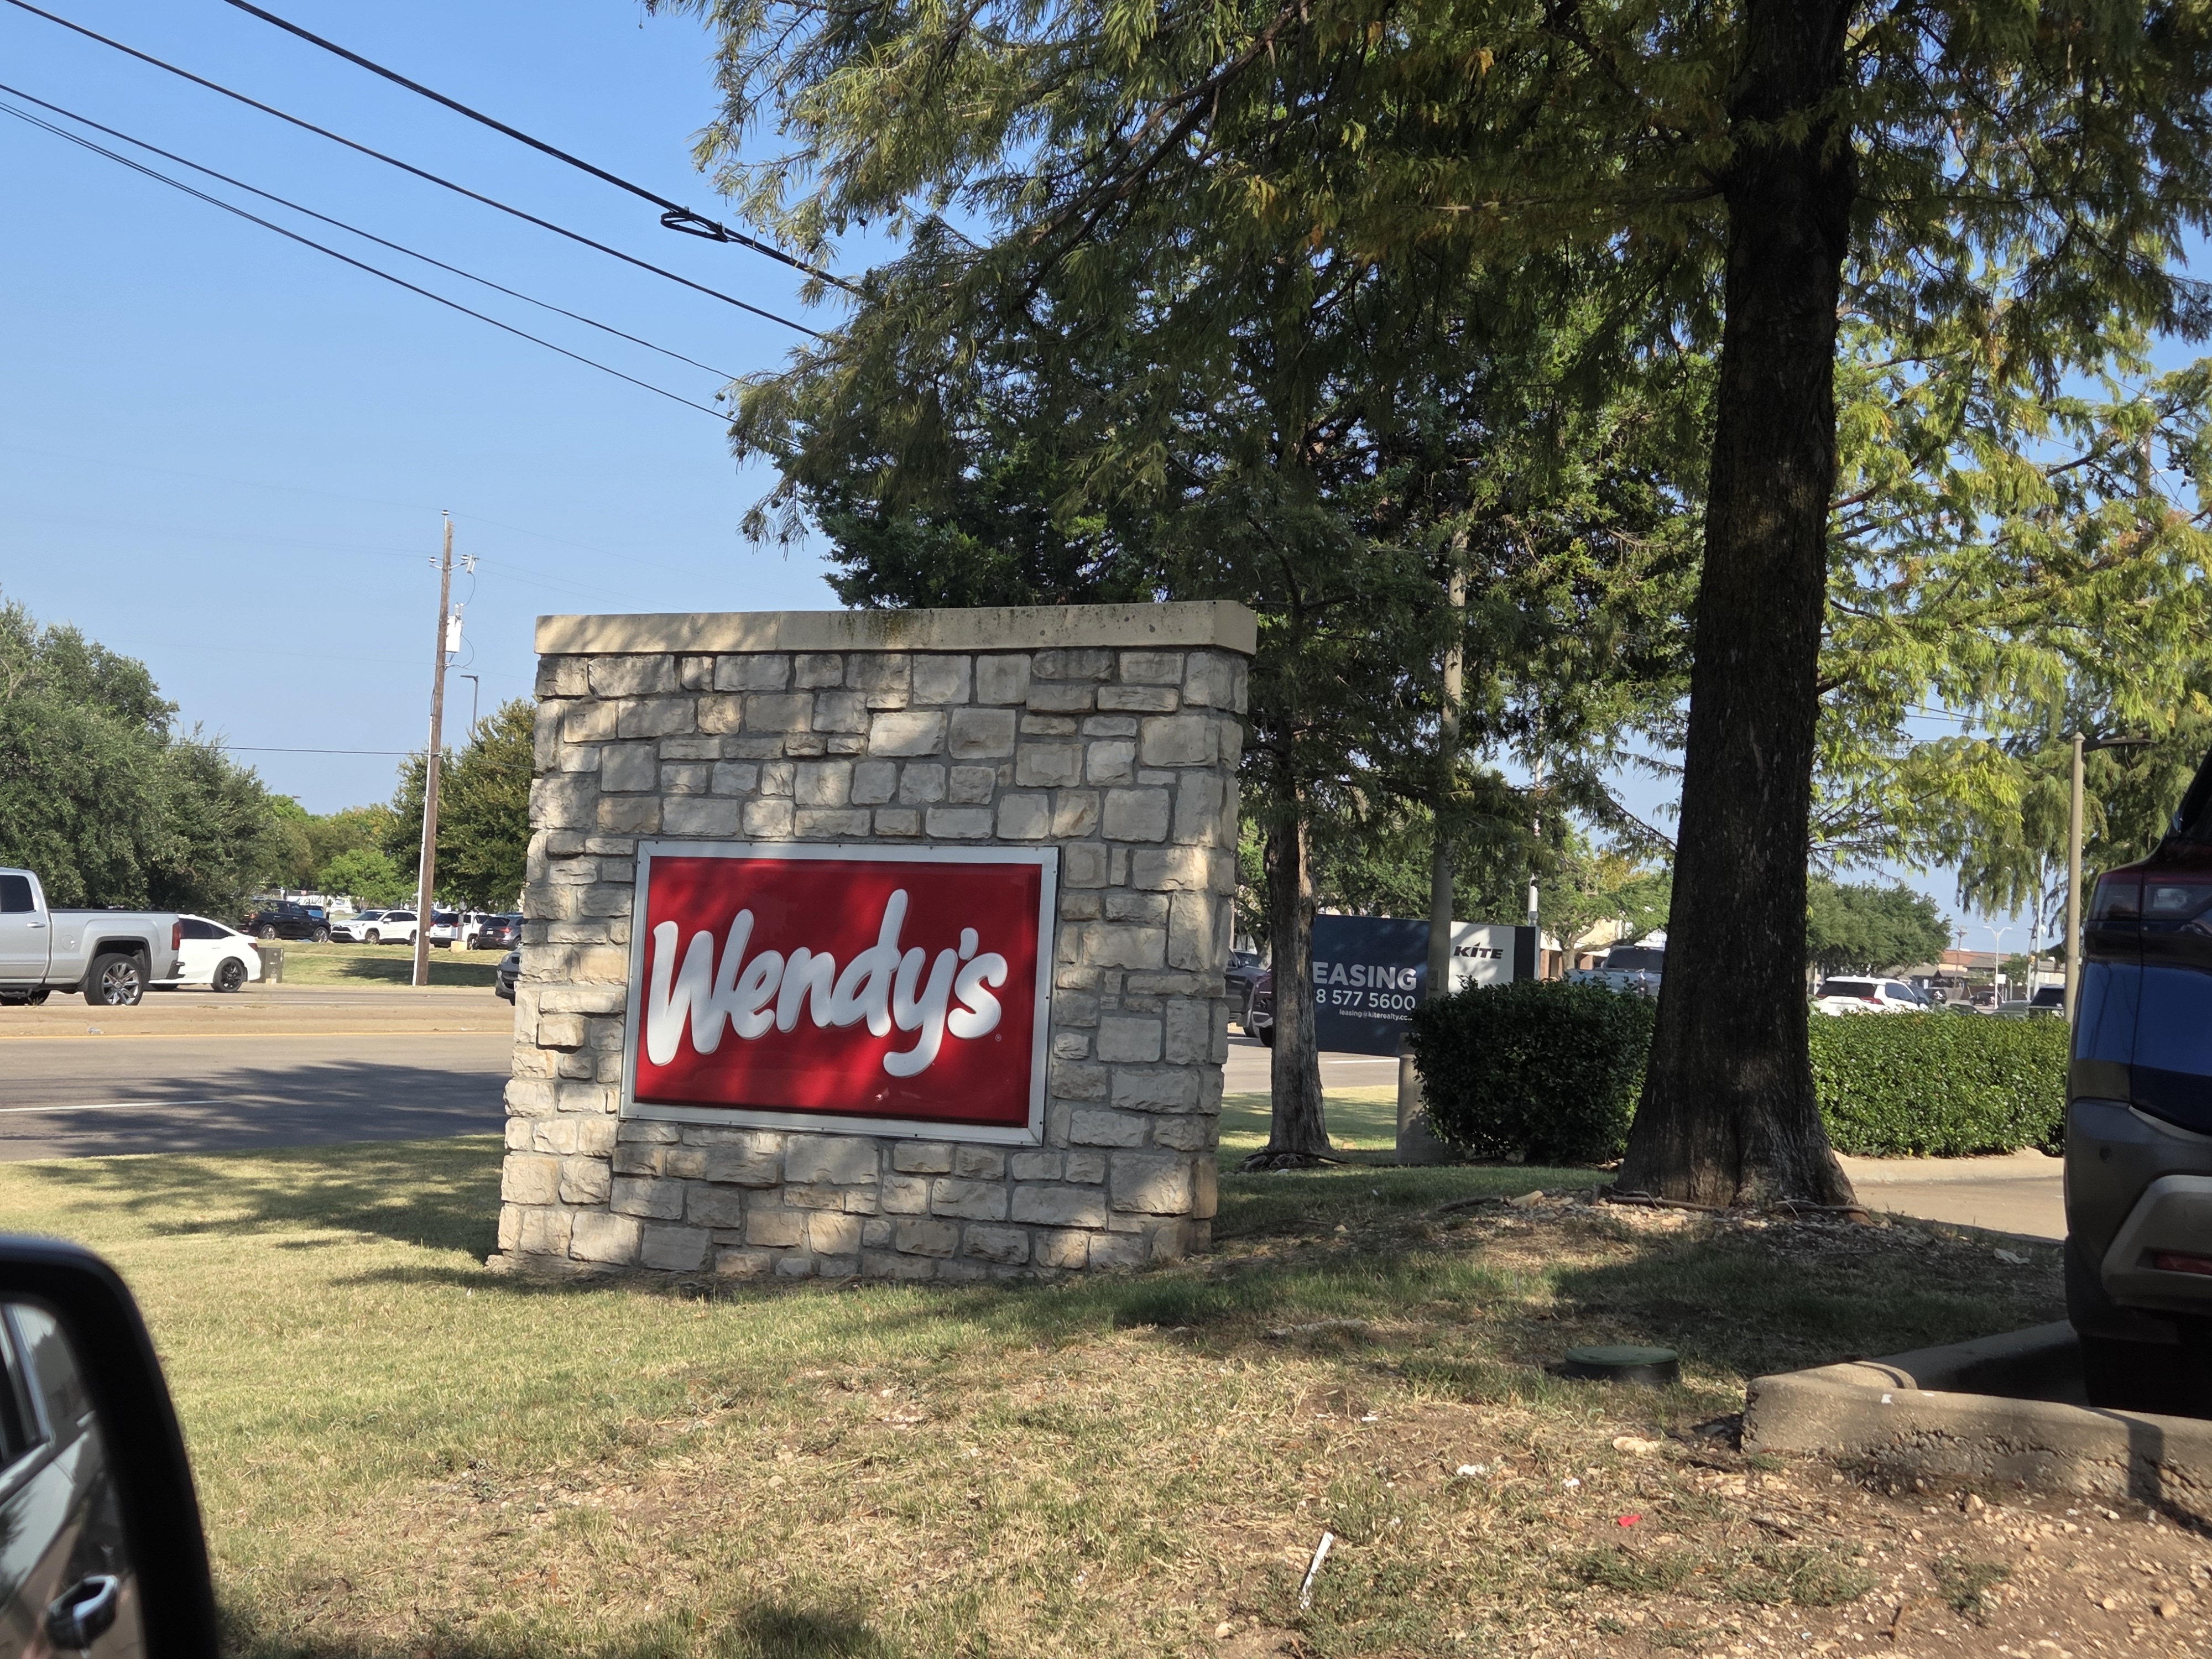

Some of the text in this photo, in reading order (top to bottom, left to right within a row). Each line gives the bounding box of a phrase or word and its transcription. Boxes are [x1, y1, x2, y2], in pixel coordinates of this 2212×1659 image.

[1453, 942, 1504, 959] KITE
[647, 888, 1008, 1078] Wendy's
[1312, 961, 1417, 991] EASING
[1314, 988, 1416, 1010] 8 577 5600
